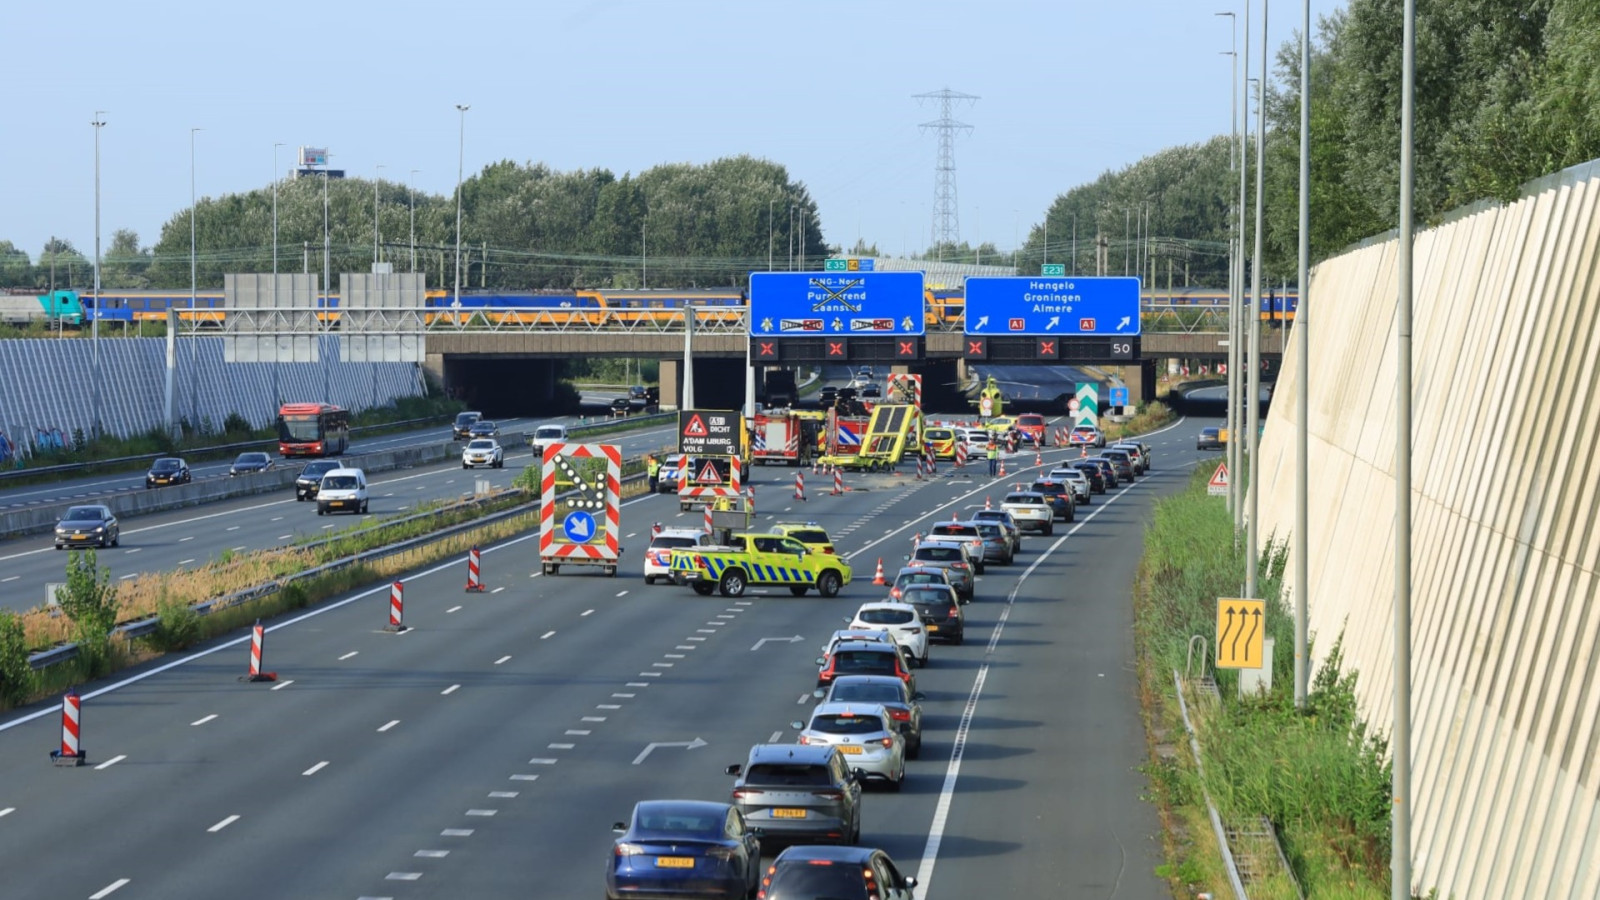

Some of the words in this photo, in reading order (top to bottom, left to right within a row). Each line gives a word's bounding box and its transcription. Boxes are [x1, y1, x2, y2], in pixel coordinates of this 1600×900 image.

[826, 261, 832, 269] E
[834, 261, 846, 269] 35
[1043, 266, 1063, 274] E231
[1030, 281, 1075, 292] Hengelo
[1024, 293, 1081, 304] Groningen
[1032, 304, 1073, 313] Almere
[1011, 320, 1023, 328] A1
[1082, 320, 1094, 328] A1
[1113, 344, 1131, 354] 50
